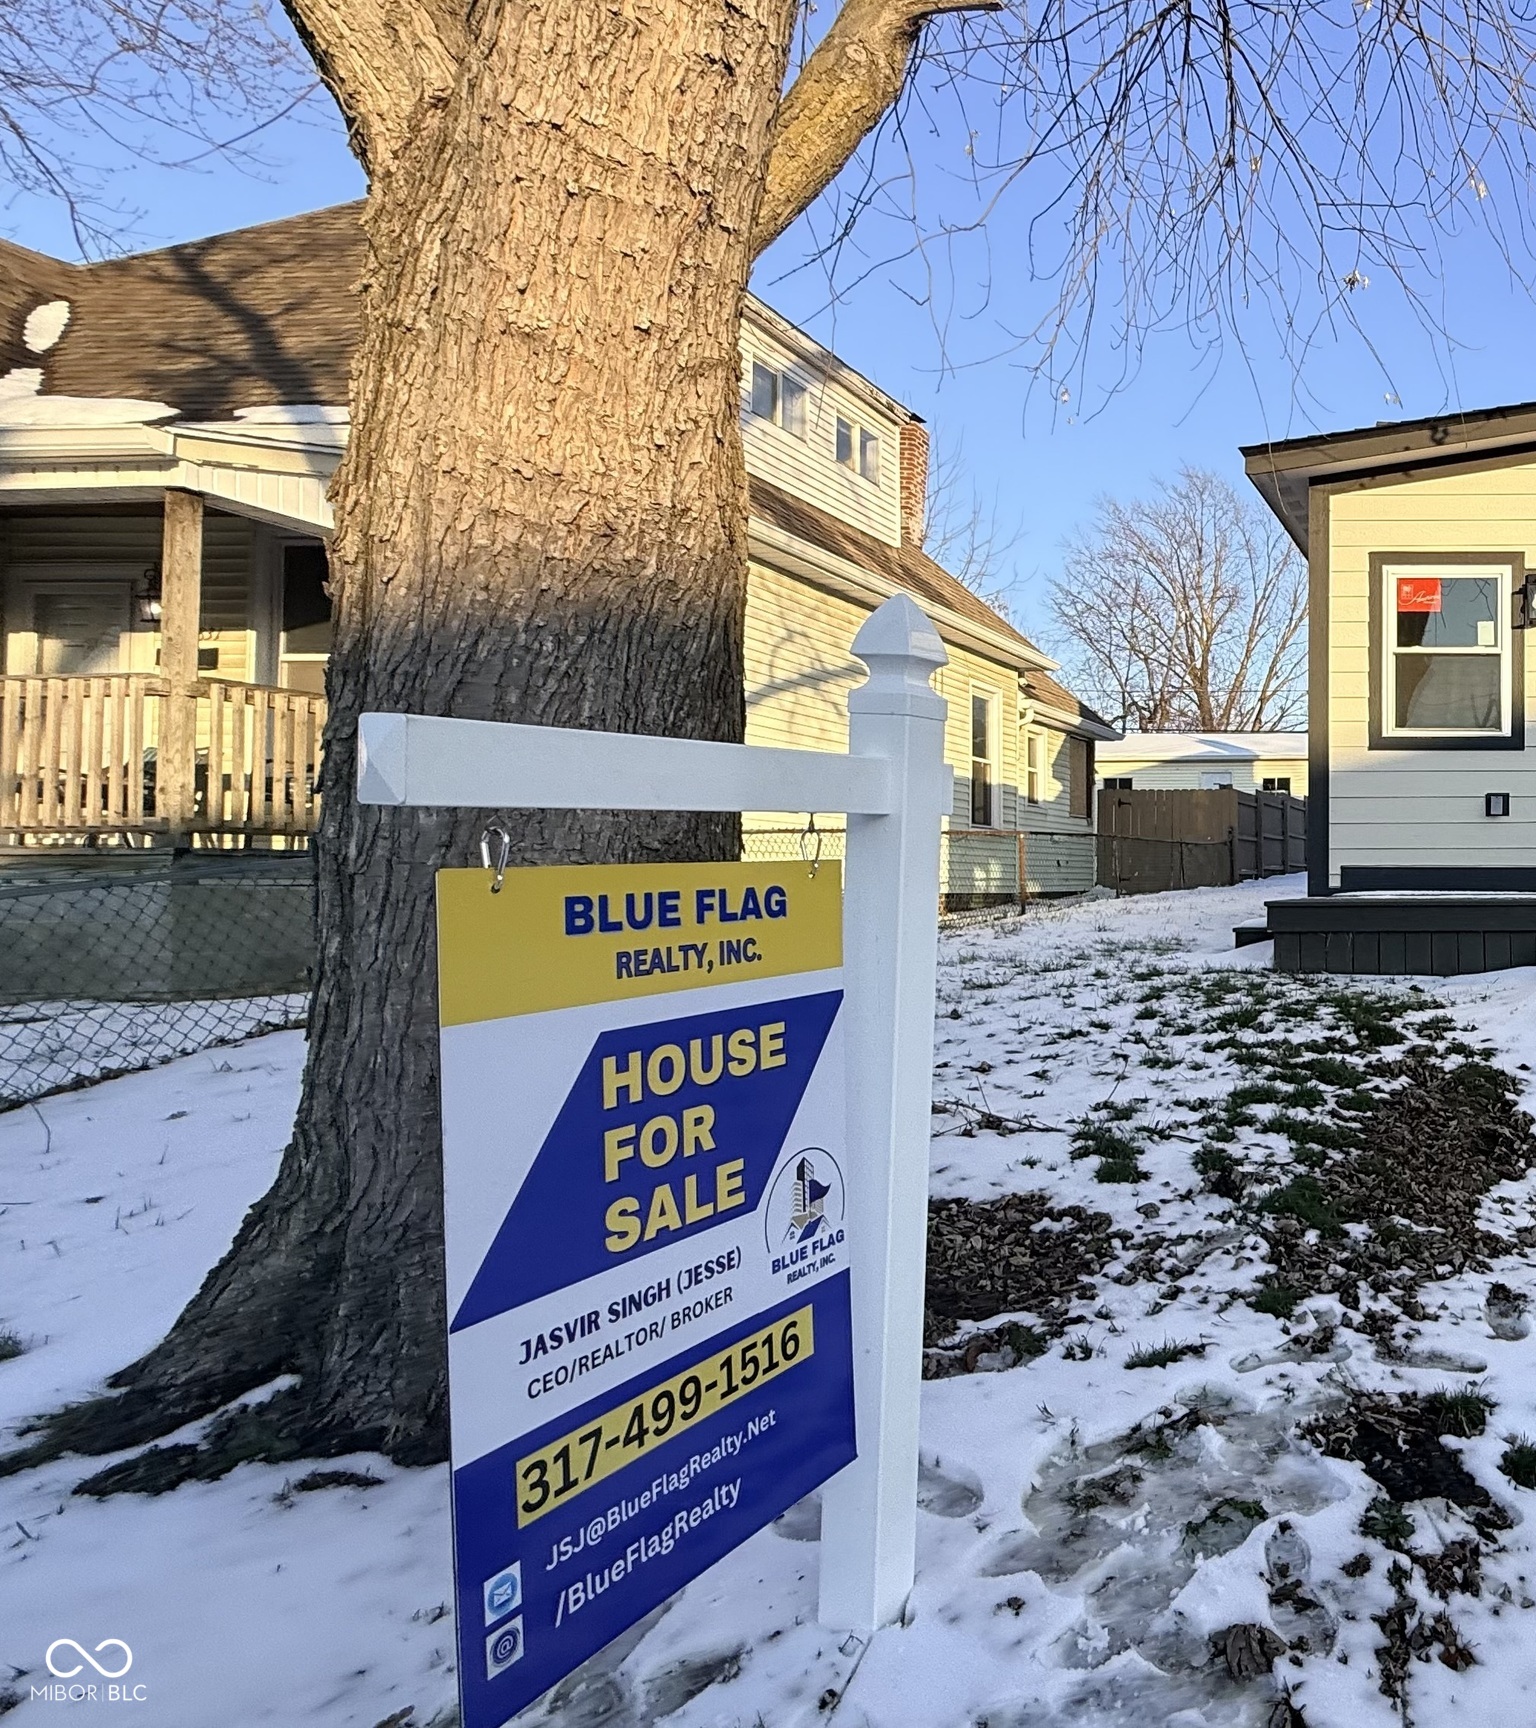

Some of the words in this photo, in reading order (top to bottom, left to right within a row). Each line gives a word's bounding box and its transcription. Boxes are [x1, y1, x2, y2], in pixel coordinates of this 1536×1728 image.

[564, 890, 682, 936] BLUE
[696, 885, 788, 925] FLAG
[616, 942, 714, 979] REALTY,
[719, 937, 763, 967] INC.
[602, 1020, 788, 1111] HOUSE
[603, 1104, 717, 1184] FOR
[604, 1157, 747, 1254] SALE
[771, 1245, 808, 1275] BLUE
[812, 1229, 845, 1256] FLAG
[518, 1309, 601, 1365] JASVIR
[607, 1277, 671, 1324] SINGH
[677, 1245, 742, 1295] (JESSE)
[786, 1260, 819, 1285] REALTY,
[820, 1252, 836, 1268] INC.
[527, 1316, 667, 1400] CEO/REALTOR/
[671, 1286, 733, 1331] BROKER
[521, 1320, 801, 1514] 317-499-1516
[545, 1408, 777, 1571] JSJ@BlueFlagRealty.Net
[554, 1477, 742, 1629] /BlueFlagRealty
